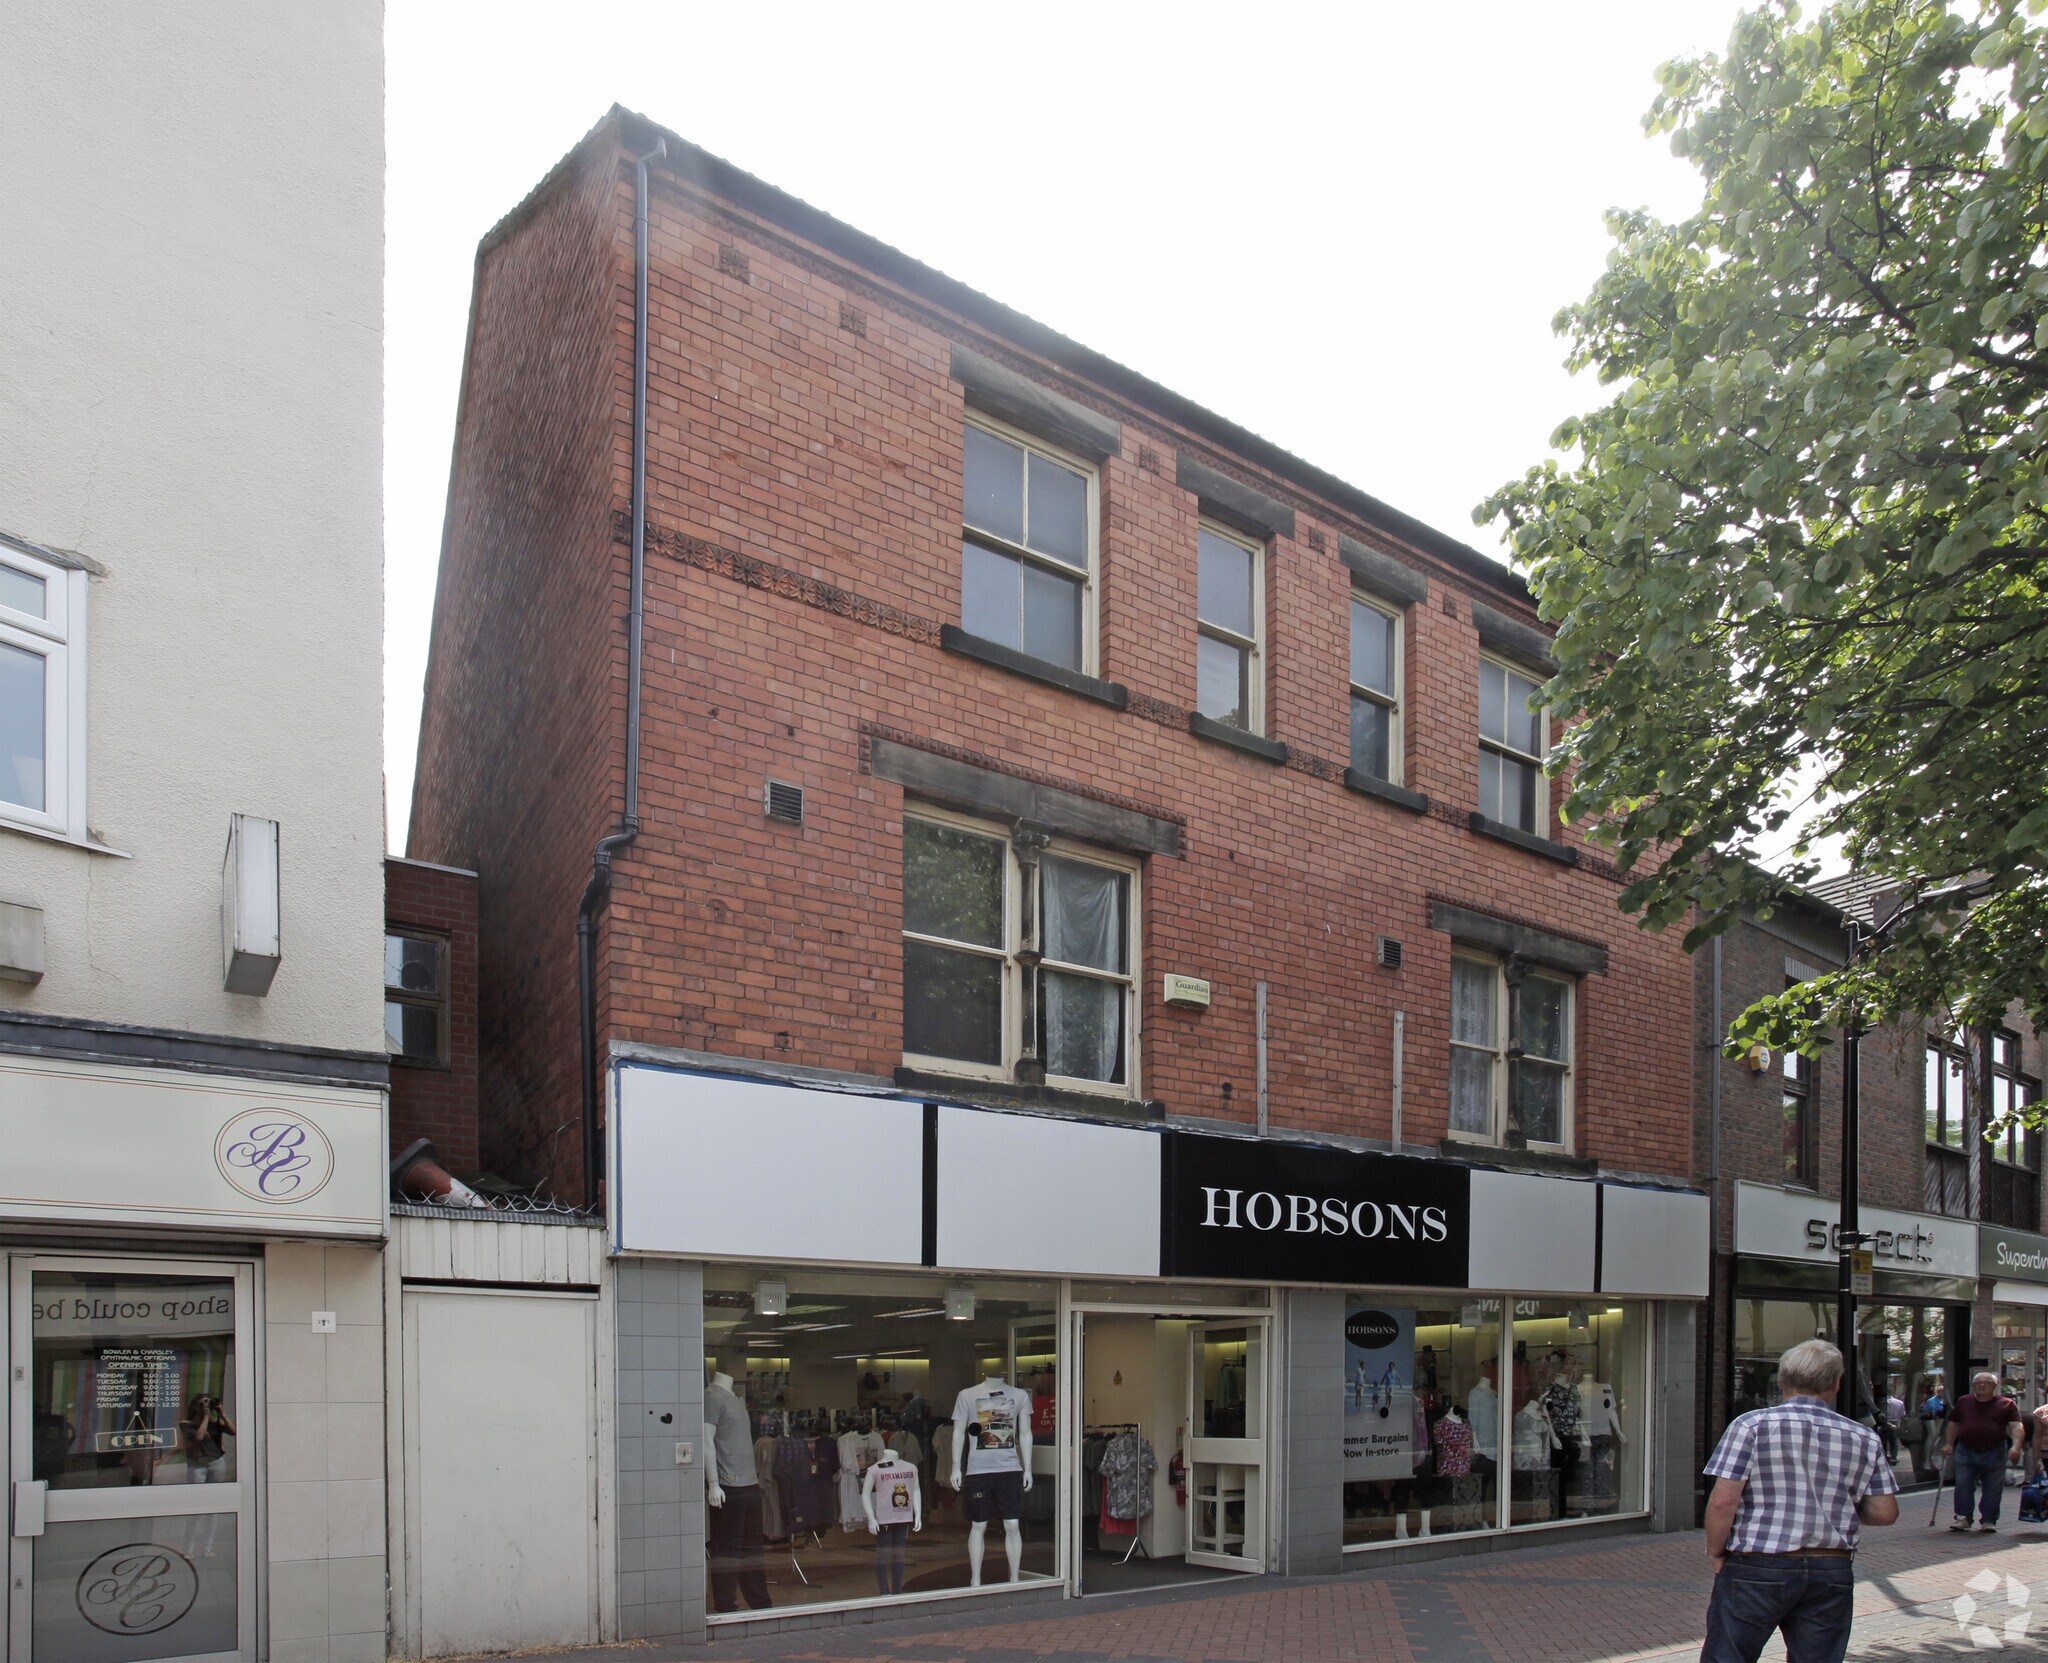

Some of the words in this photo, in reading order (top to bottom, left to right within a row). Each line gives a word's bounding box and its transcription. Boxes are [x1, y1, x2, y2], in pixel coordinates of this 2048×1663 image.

[1175, 980, 1209, 993] Guardian
[1200, 1186, 1448, 1242] HOBSONS
[1807, 1218, 1933, 1263] sect
[1347, 1325, 1396, 1335] HOBSONS
[111, 1434, 163, 1447] OPEN
[1371, 1433, 1409, 1445] Bargains
[1344, 1447, 1363, 1458] Now
[1365, 1446, 1400, 1457] In-store
